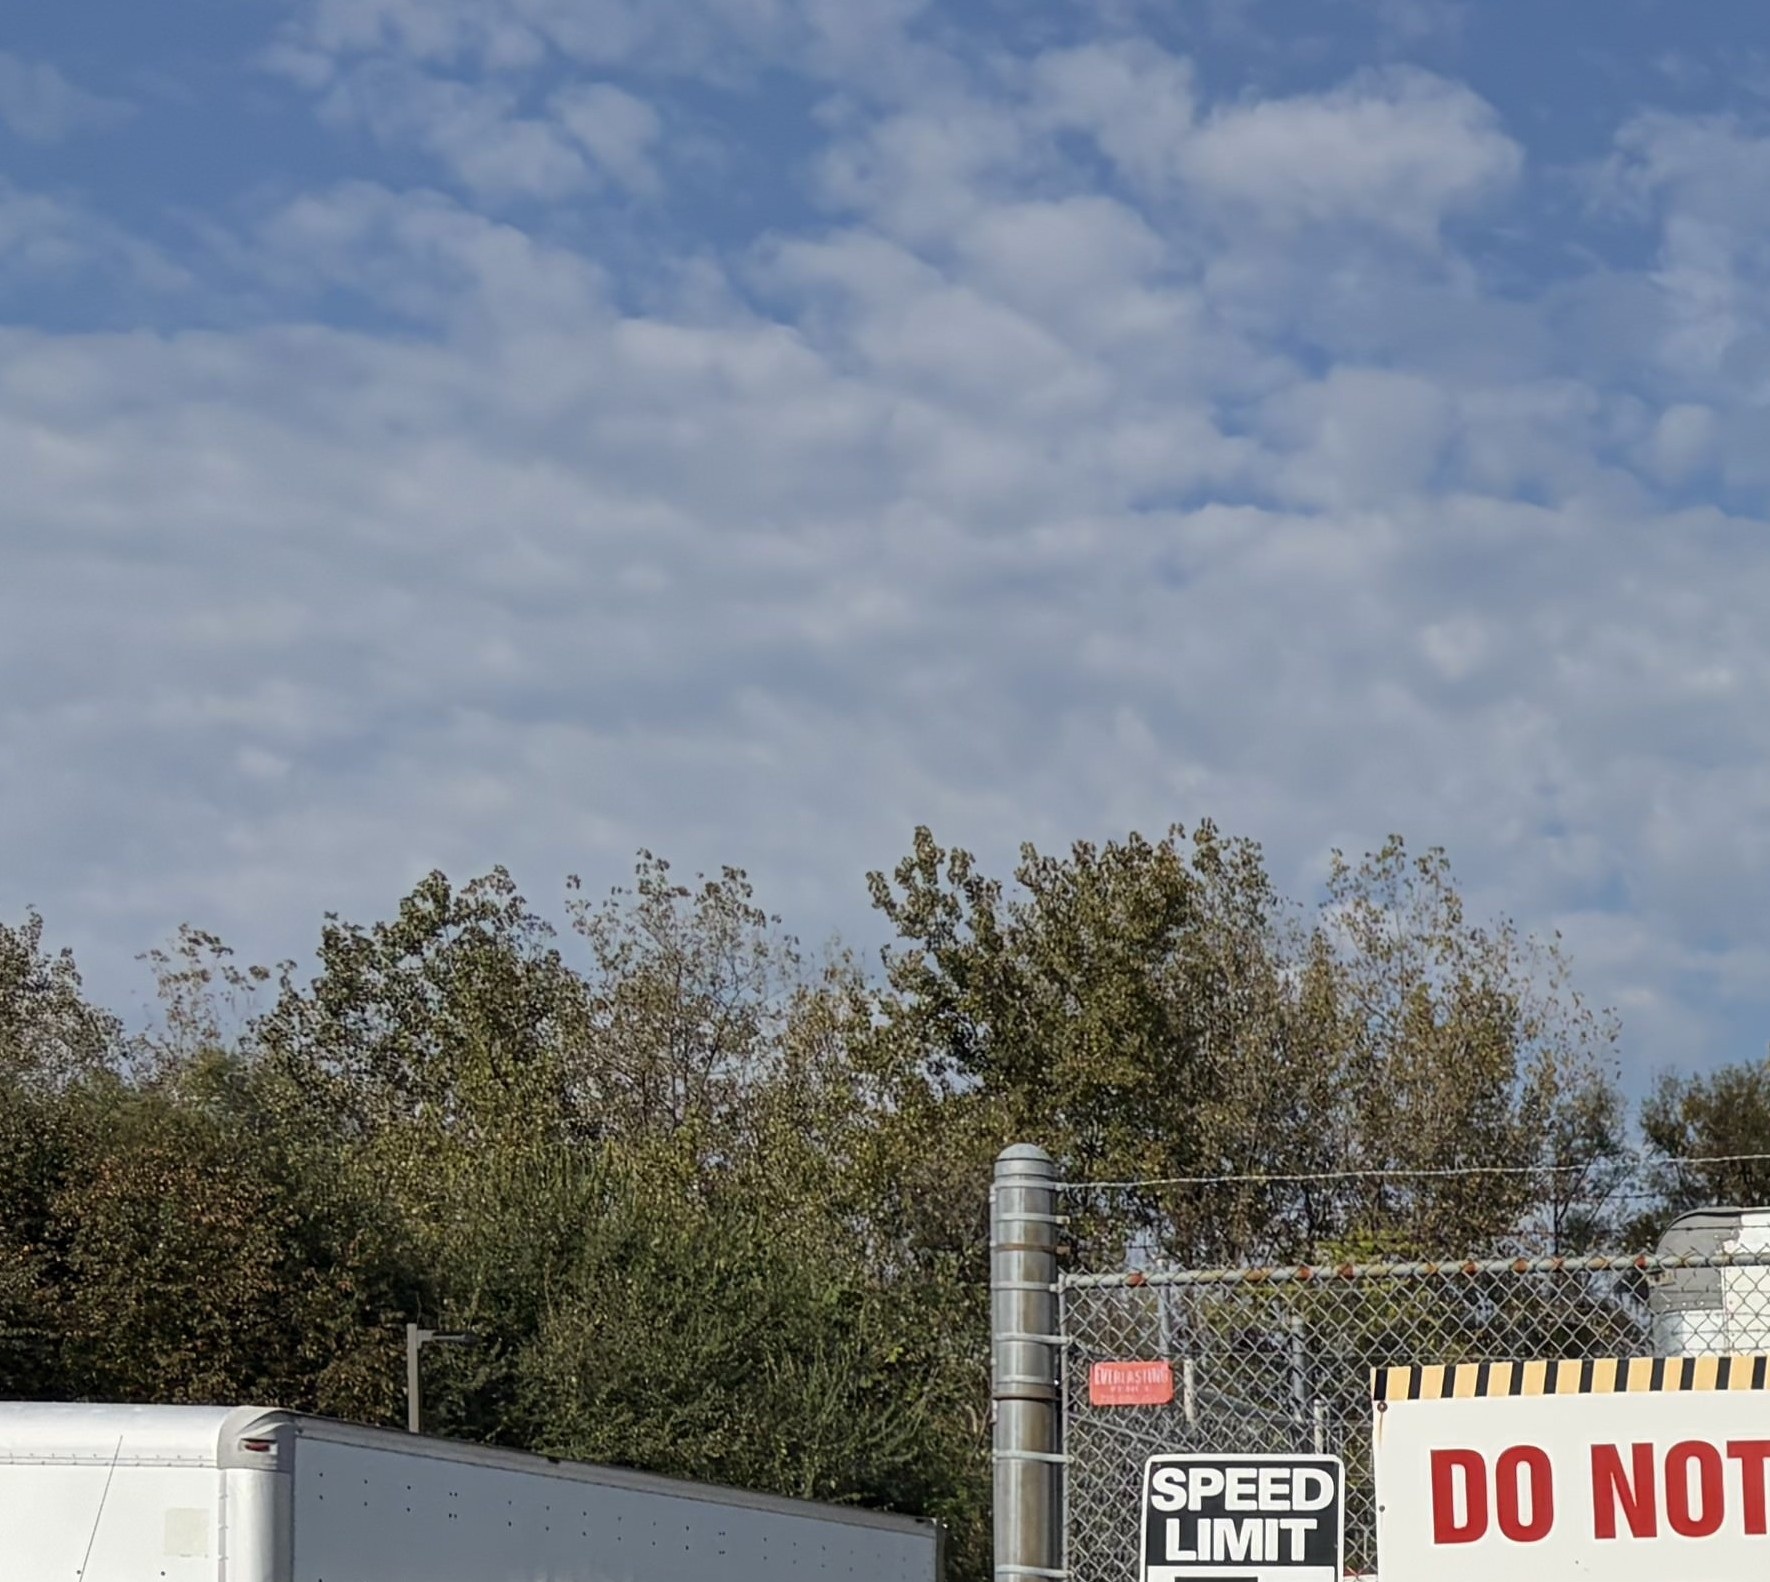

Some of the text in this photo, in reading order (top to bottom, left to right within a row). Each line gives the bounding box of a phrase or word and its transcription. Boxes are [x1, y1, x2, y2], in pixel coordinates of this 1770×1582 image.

[1151, 1466, 1335, 1512] SPEED
[1430, 1444, 1555, 1545] DO
[1165, 1517, 1318, 1562] LIMIT
